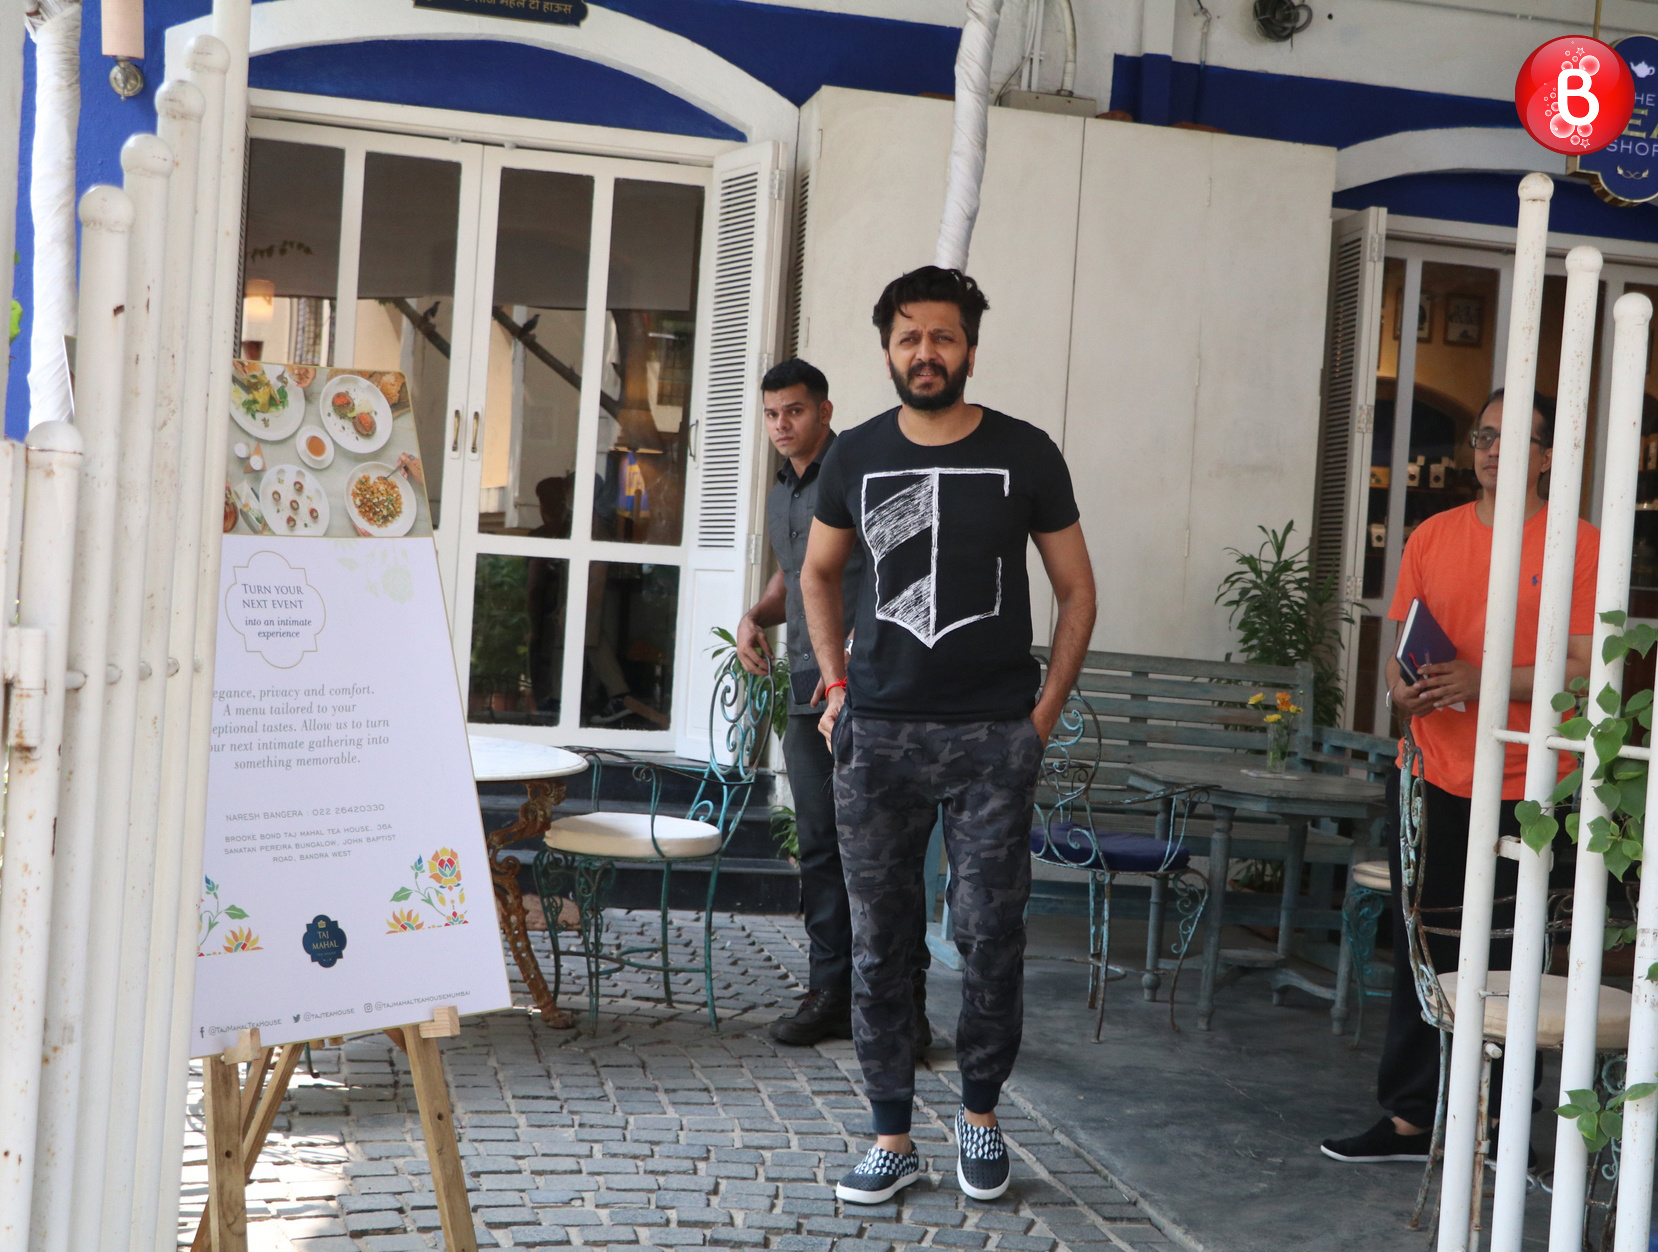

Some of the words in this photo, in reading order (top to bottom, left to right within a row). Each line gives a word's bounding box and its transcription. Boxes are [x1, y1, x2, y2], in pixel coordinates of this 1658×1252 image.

[1634, 92, 1656, 106] HE
[242, 584, 272, 594] TURN
[274, 585, 304, 595] YOUR
[242, 600, 268, 608] NEXT
[272, 600, 304, 609] EVENT
[245, 616, 262, 626] into
[278, 616, 312, 626] intimate
[258, 628, 300, 640] experience
[212, 690, 256, 701] egance,
[259, 686, 300, 700] privacy
[304, 684, 325, 697] and
[329, 683, 374, 698] comfort.
[223, 704, 231, 716] A
[236, 706, 266, 716] menu
[270, 702, 313, 715] tailored
[317, 704, 328, 714] to
[332, 703, 356, 716] your
[262, 722, 296, 732] tastes.
[301, 719, 332, 732] Allow
[336, 721, 348, 730] us
[352, 718, 362, 729] to
[366, 718, 390, 728] turn
[210, 742, 226, 752] our
[230, 742, 252, 752] next
[258, 738, 304, 750] intimate
[308, 736, 362, 752] gathering
[367, 734, 390, 745] into
[234, 756, 292, 770] something
[296, 752, 360, 767] memorable.
[226, 813, 260, 822] NARESH
[264, 810, 304, 820] BANGERA
[312, 808, 331, 816] 022
[225, 834, 257, 843] BROOKE
[260, 832, 281, 840] BOND
[300, 829, 324, 838] MAHAL
[224, 846, 256, 855] SANATAN
[260, 844, 292, 852] PEREIRA
[342, 838, 363, 846] JOHN
[366, 834, 396, 843] BAPTIST
[300, 852, 329, 860] BANDRA
[317, 930, 330, 940] TAJ
[312, 940, 338, 950] MAHAL
